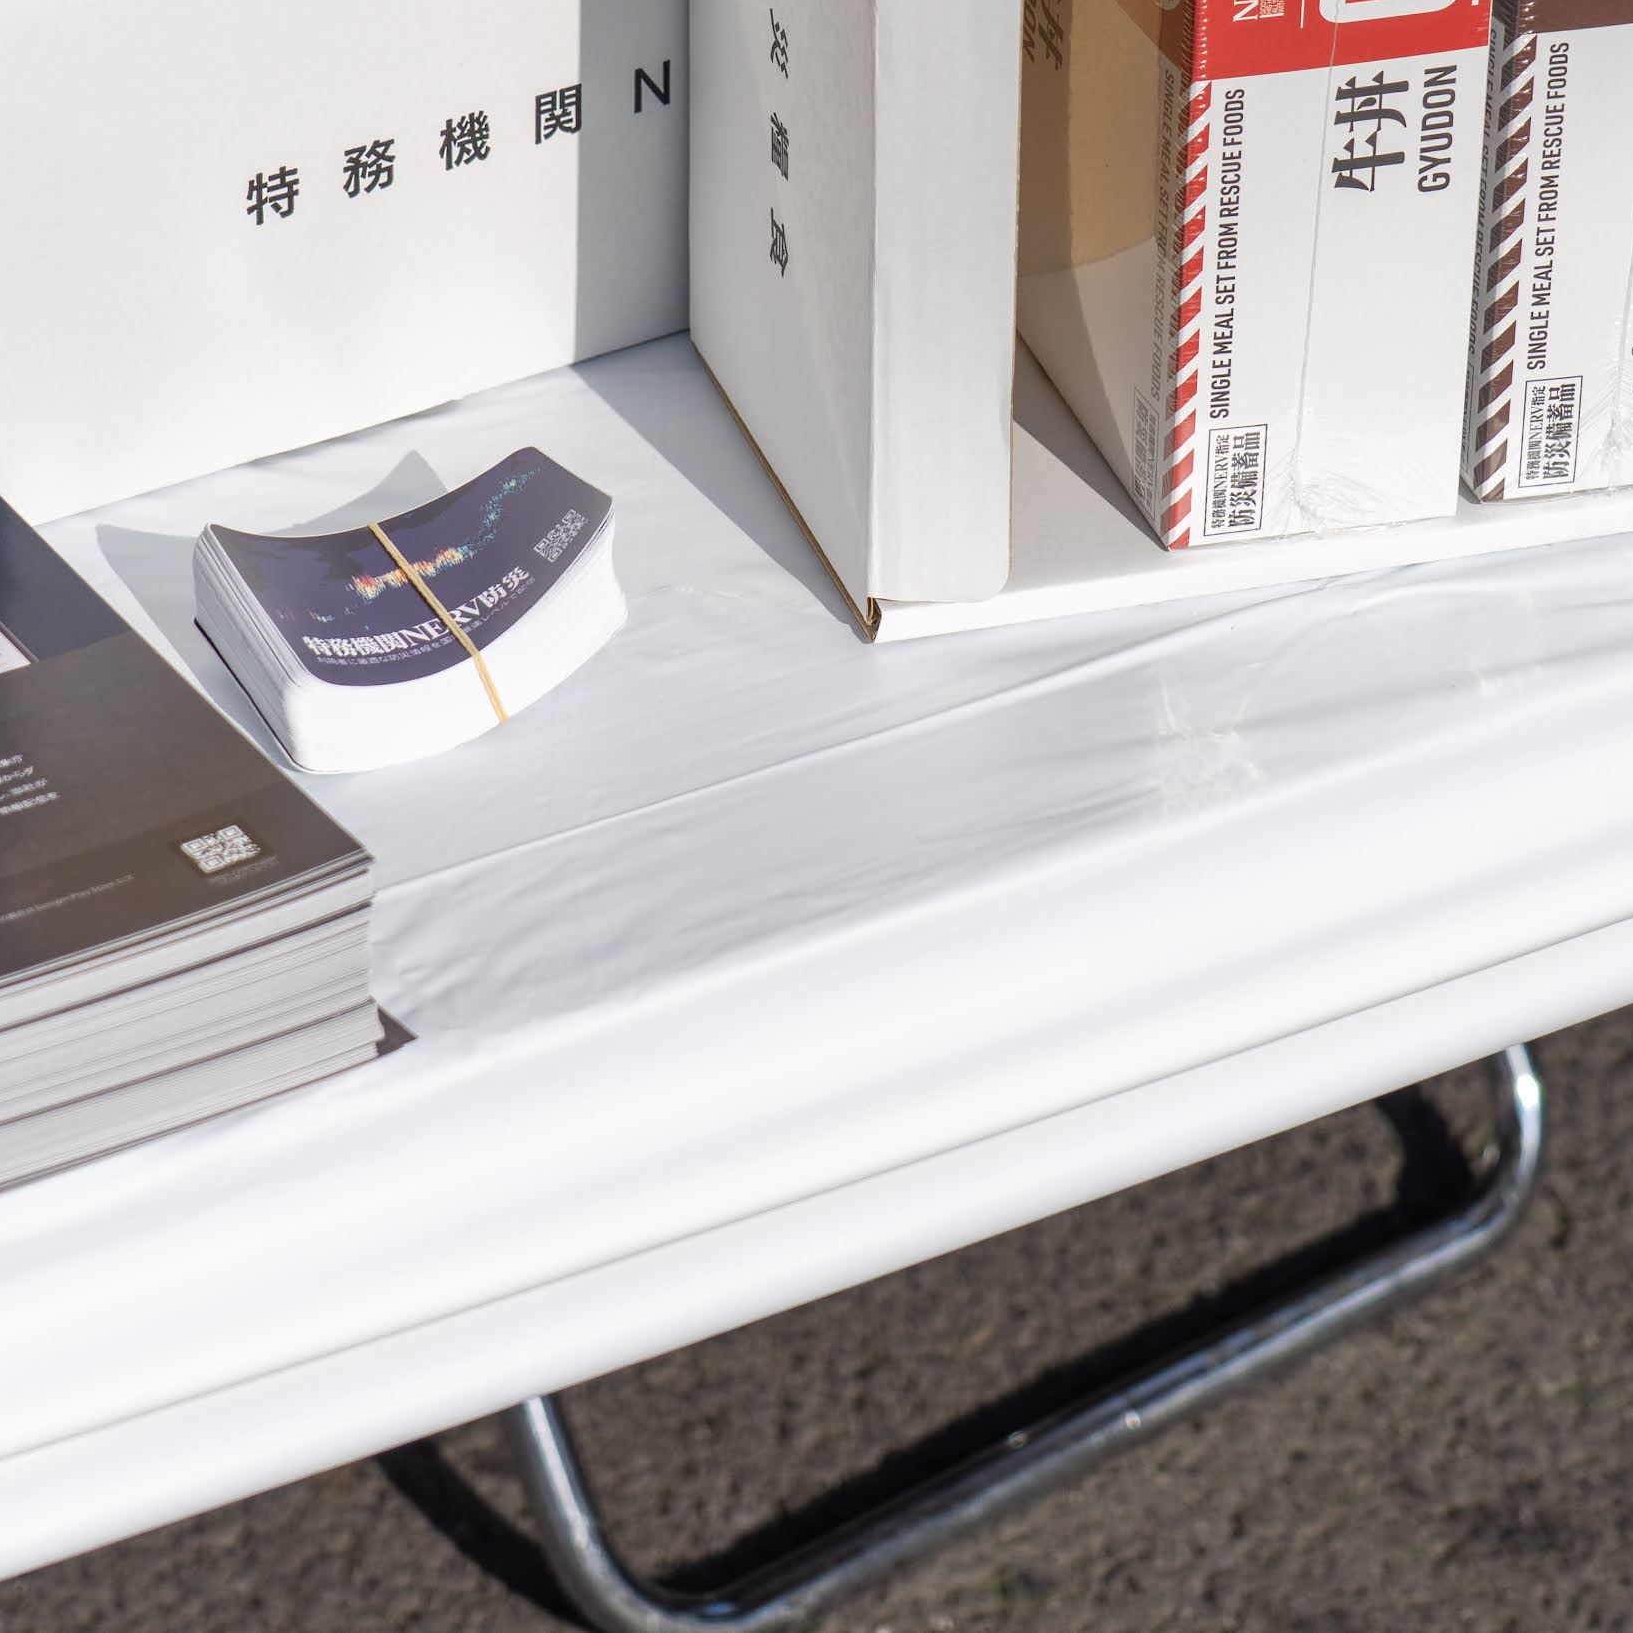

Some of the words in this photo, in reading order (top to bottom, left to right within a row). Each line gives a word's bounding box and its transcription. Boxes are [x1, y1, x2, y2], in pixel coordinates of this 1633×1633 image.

[1548, 42, 1570, 100] FOODS
[244, 59, 671, 225] 特務機関N
[1224, 88, 1245, 144] FOODS
[1331, 69, 1409, 193] 牛丼
[1417, 64, 1457, 194] GYUDON
[1541, 103, 1565, 171] RESCUE
[1220, 150, 1242, 219] RESCUE
[1538, 174, 1560, 221] FROM
[1218, 223, 1238, 268] FROM
[1536, 223, 1554, 258] SET
[1216, 269, 1235, 304] SET
[1531, 259, 1552, 309] MEAL
[1213, 307, 1234, 358] MEAL
[1527, 313, 1547, 370] SINGLE
[1209, 363, 1232, 420] SINGLE
[1524, 384, 1546, 481] 特務機関NERV指定
[1542, 381, 1577, 481] 防災備蓄品
[1210, 433, 1231, 530] 特務機関NERV指定
[1227, 430, 1263, 531] 防災備蓄品
